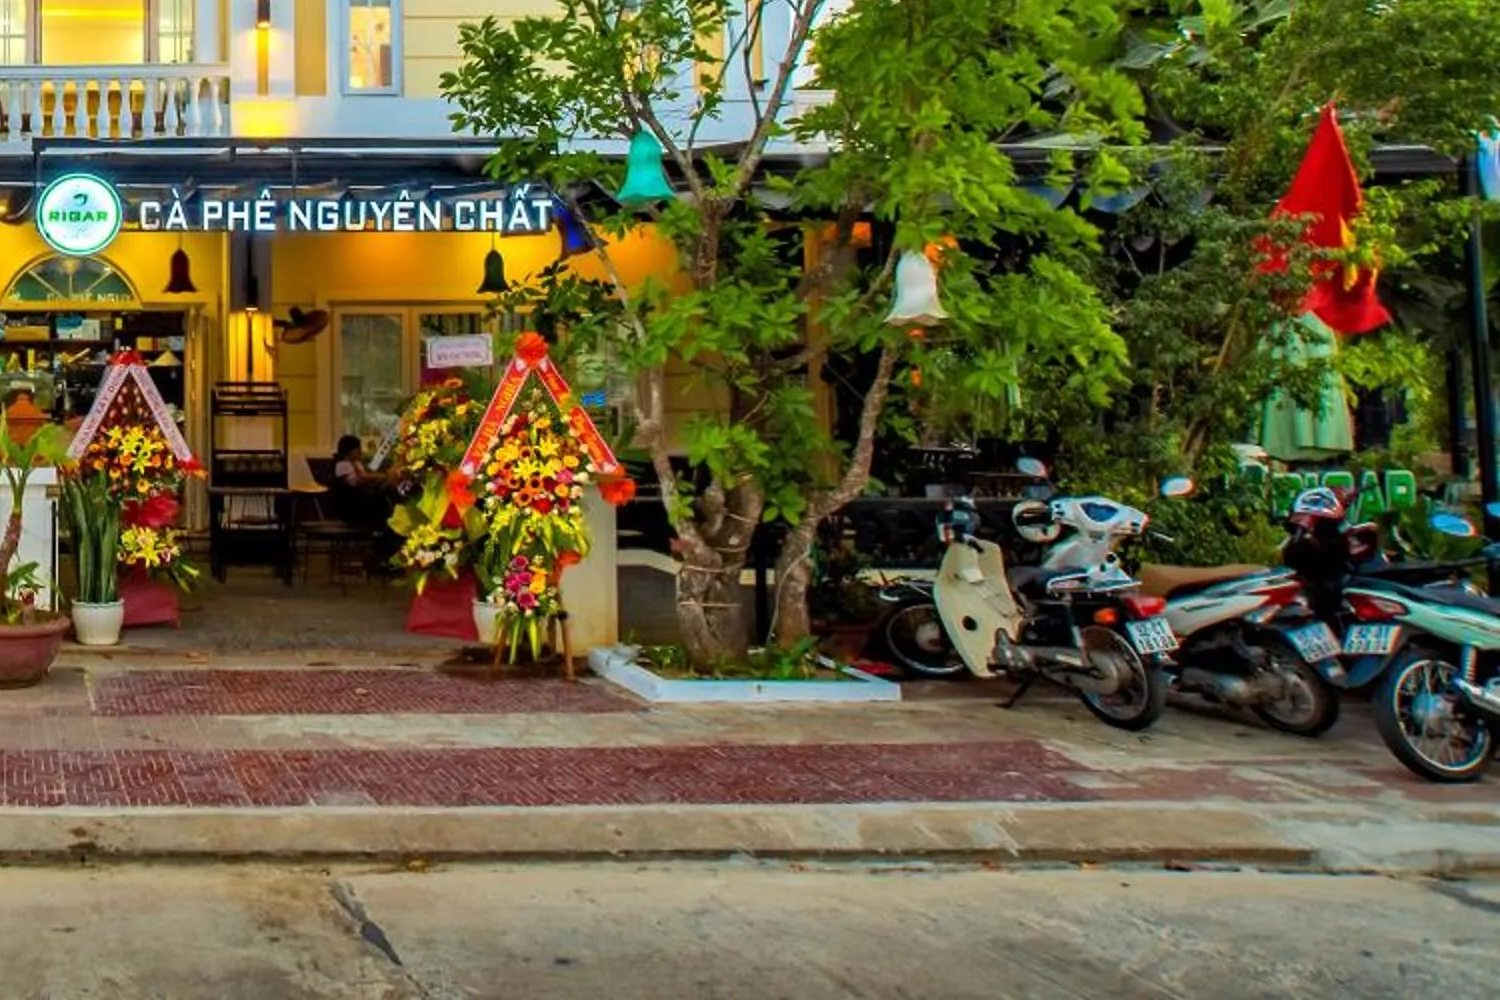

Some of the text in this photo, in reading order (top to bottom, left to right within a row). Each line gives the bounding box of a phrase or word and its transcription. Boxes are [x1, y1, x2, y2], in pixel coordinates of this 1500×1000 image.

[140, 183, 553, 231] CÀ PHÊ NGUYÊN CHẤT
